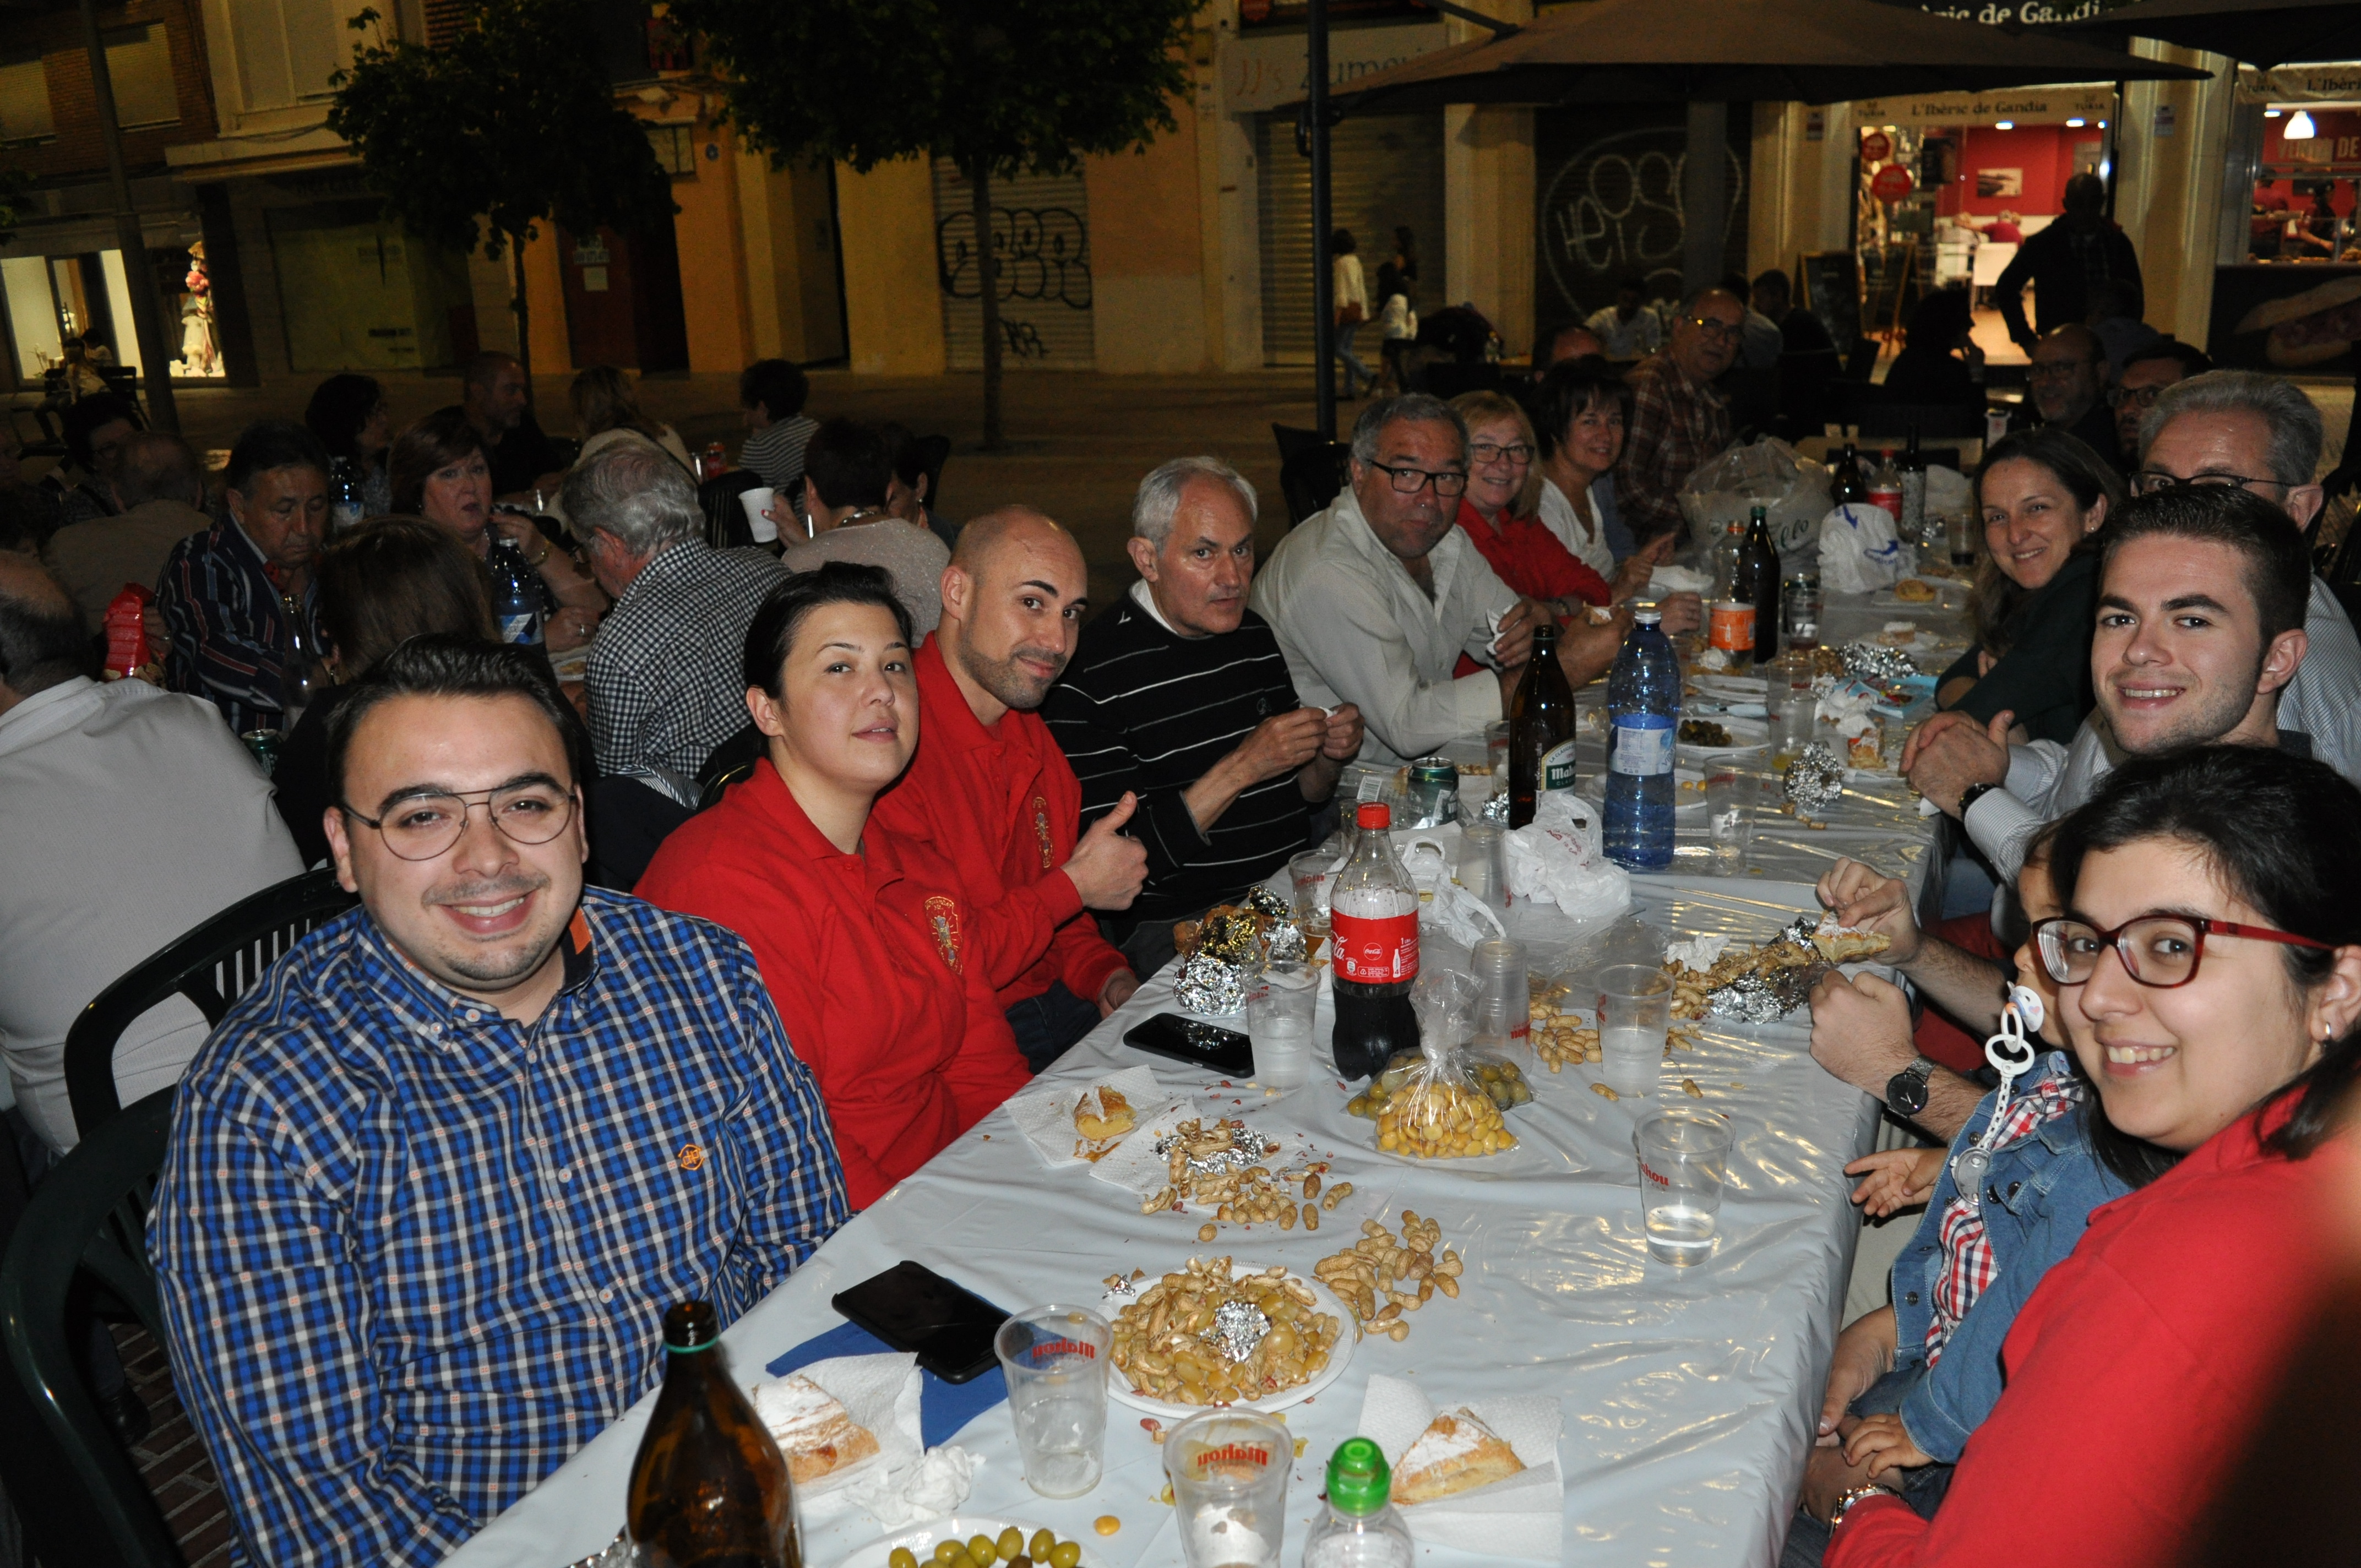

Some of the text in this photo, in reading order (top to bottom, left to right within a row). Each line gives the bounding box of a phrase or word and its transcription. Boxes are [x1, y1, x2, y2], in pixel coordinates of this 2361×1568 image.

[1978, 3, 2012, 25] de
[1973, 104, 1989, 114] de
[1996, 100, 2047, 113] Gandia
